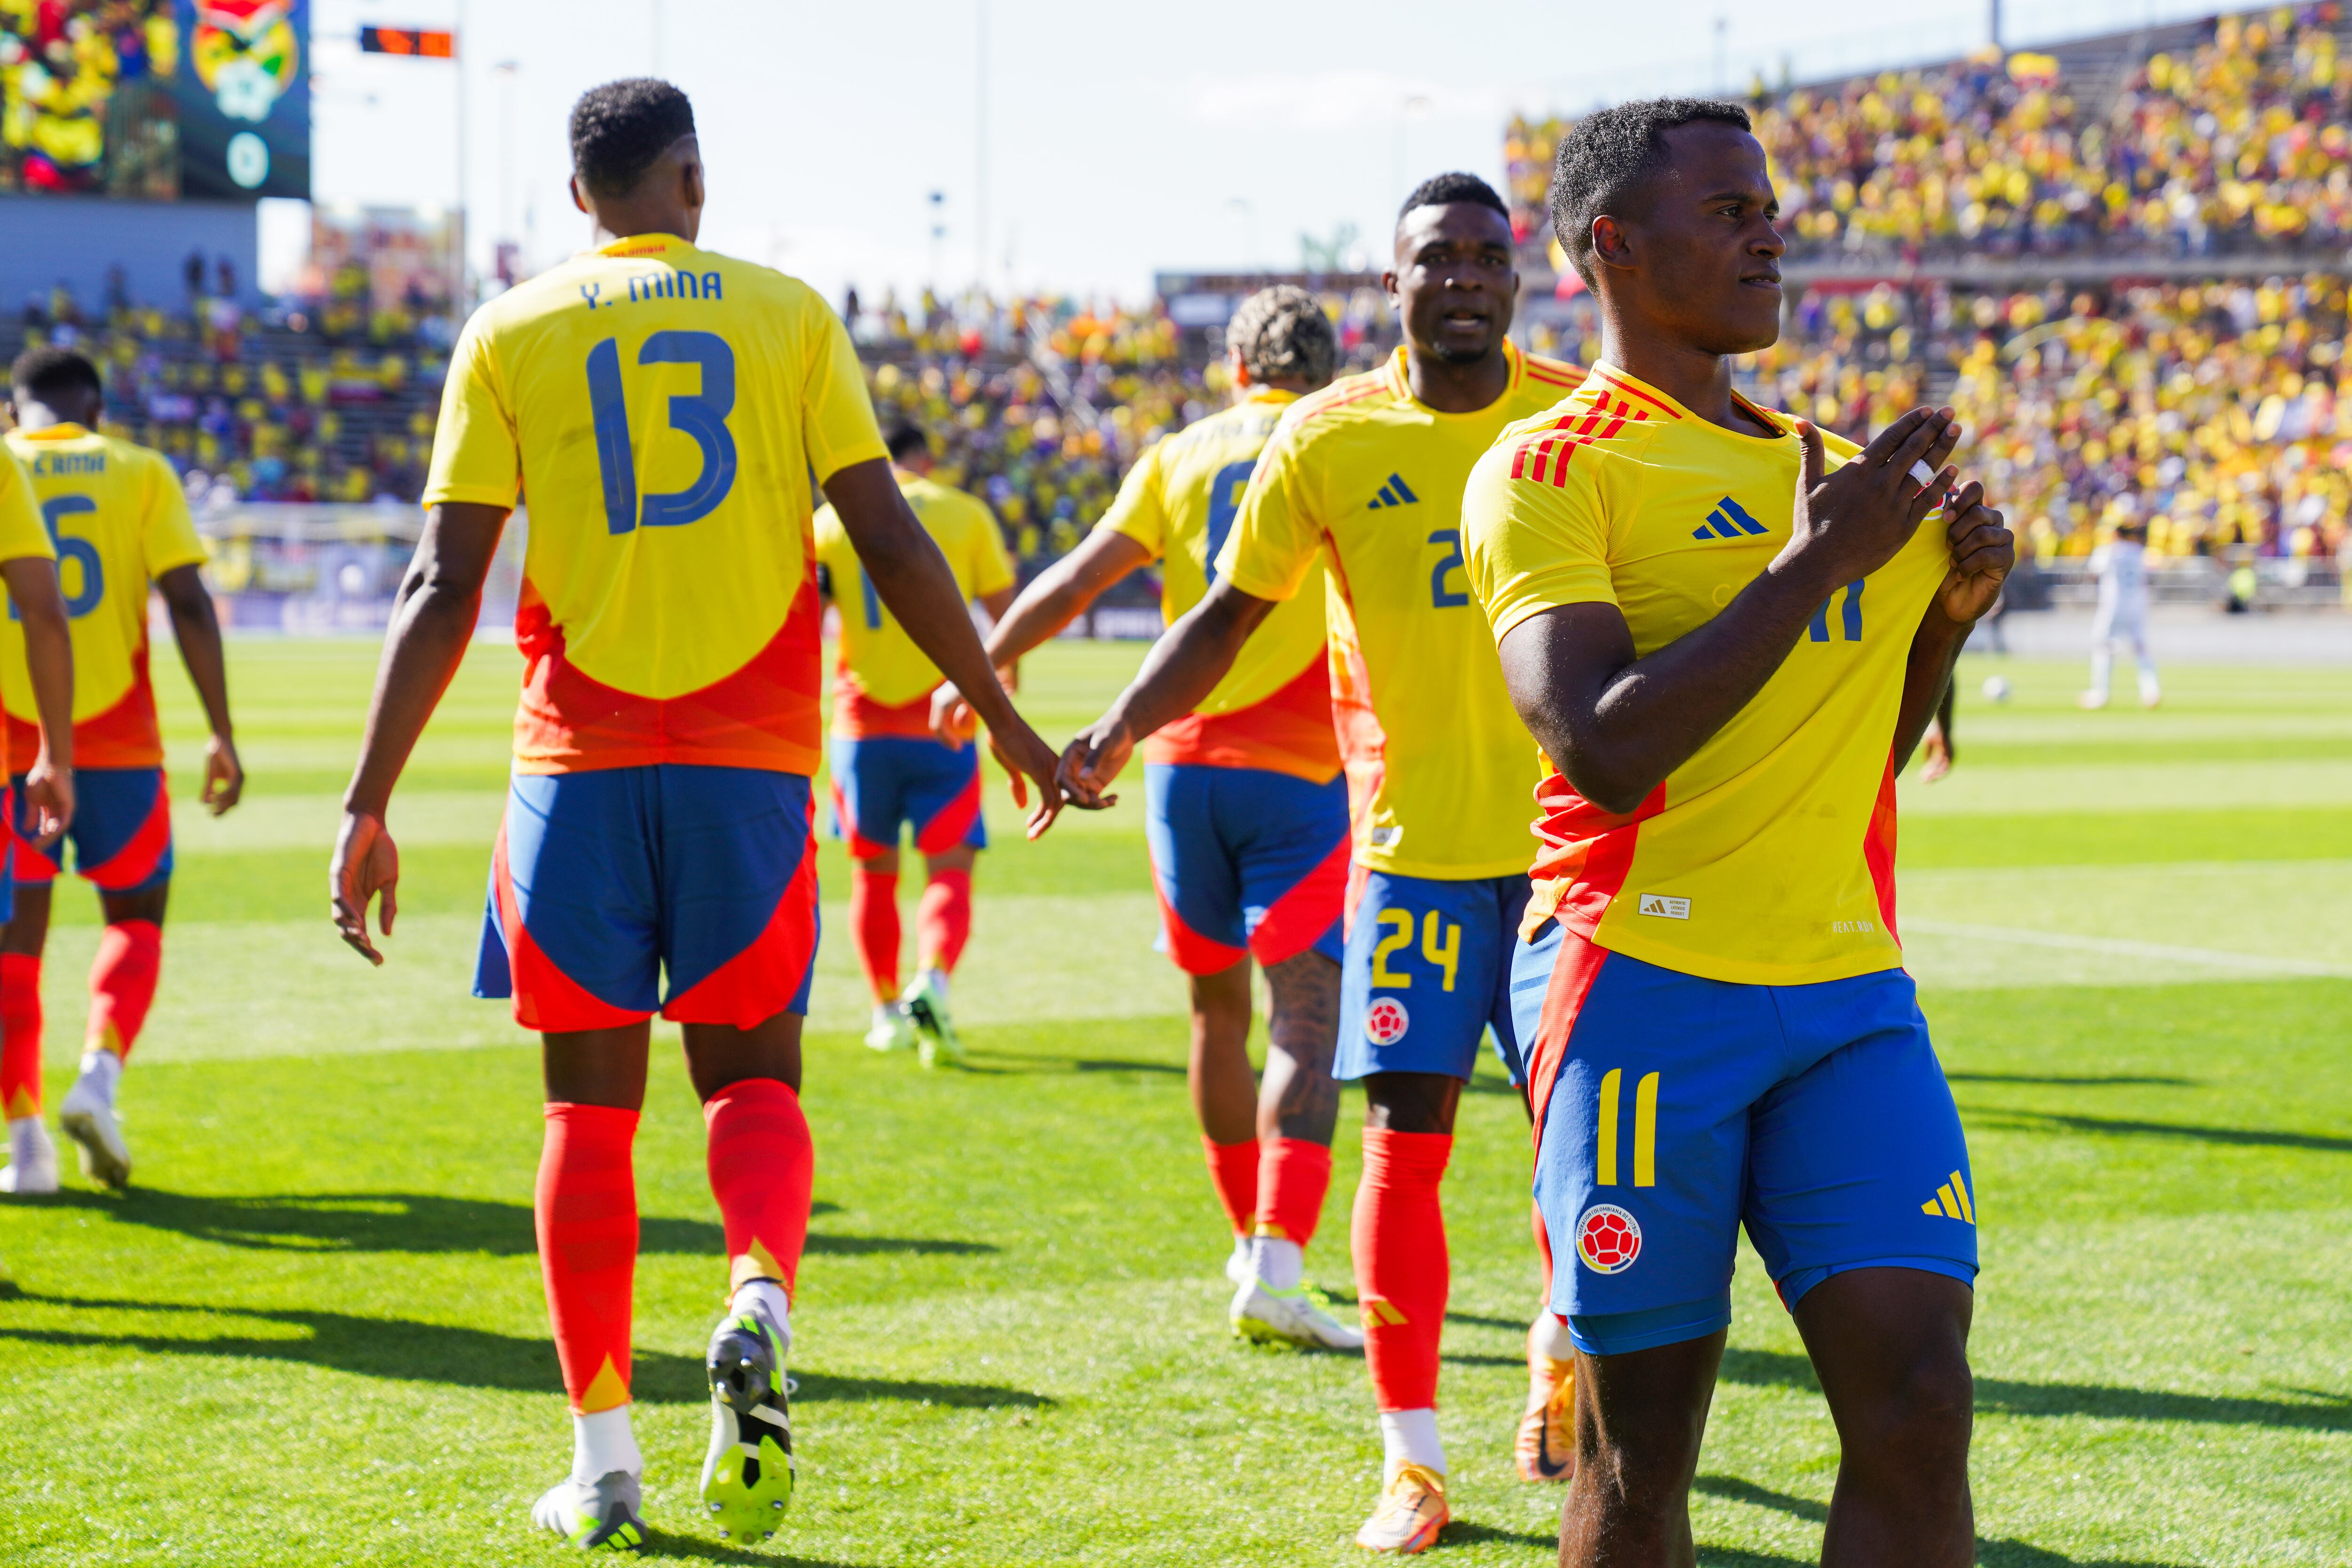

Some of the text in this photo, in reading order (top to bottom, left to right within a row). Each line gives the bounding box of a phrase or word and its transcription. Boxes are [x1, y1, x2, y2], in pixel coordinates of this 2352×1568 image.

[227, 132, 270, 187] 0
[586, 330, 737, 535] 13
[1372, 908, 1461, 992] 24
[1833, 921, 1874, 933] HEAT.RDY
[1597, 1068, 1660, 1187] 11
[1591, 1206, 1622, 1216] COLOMBIANA
